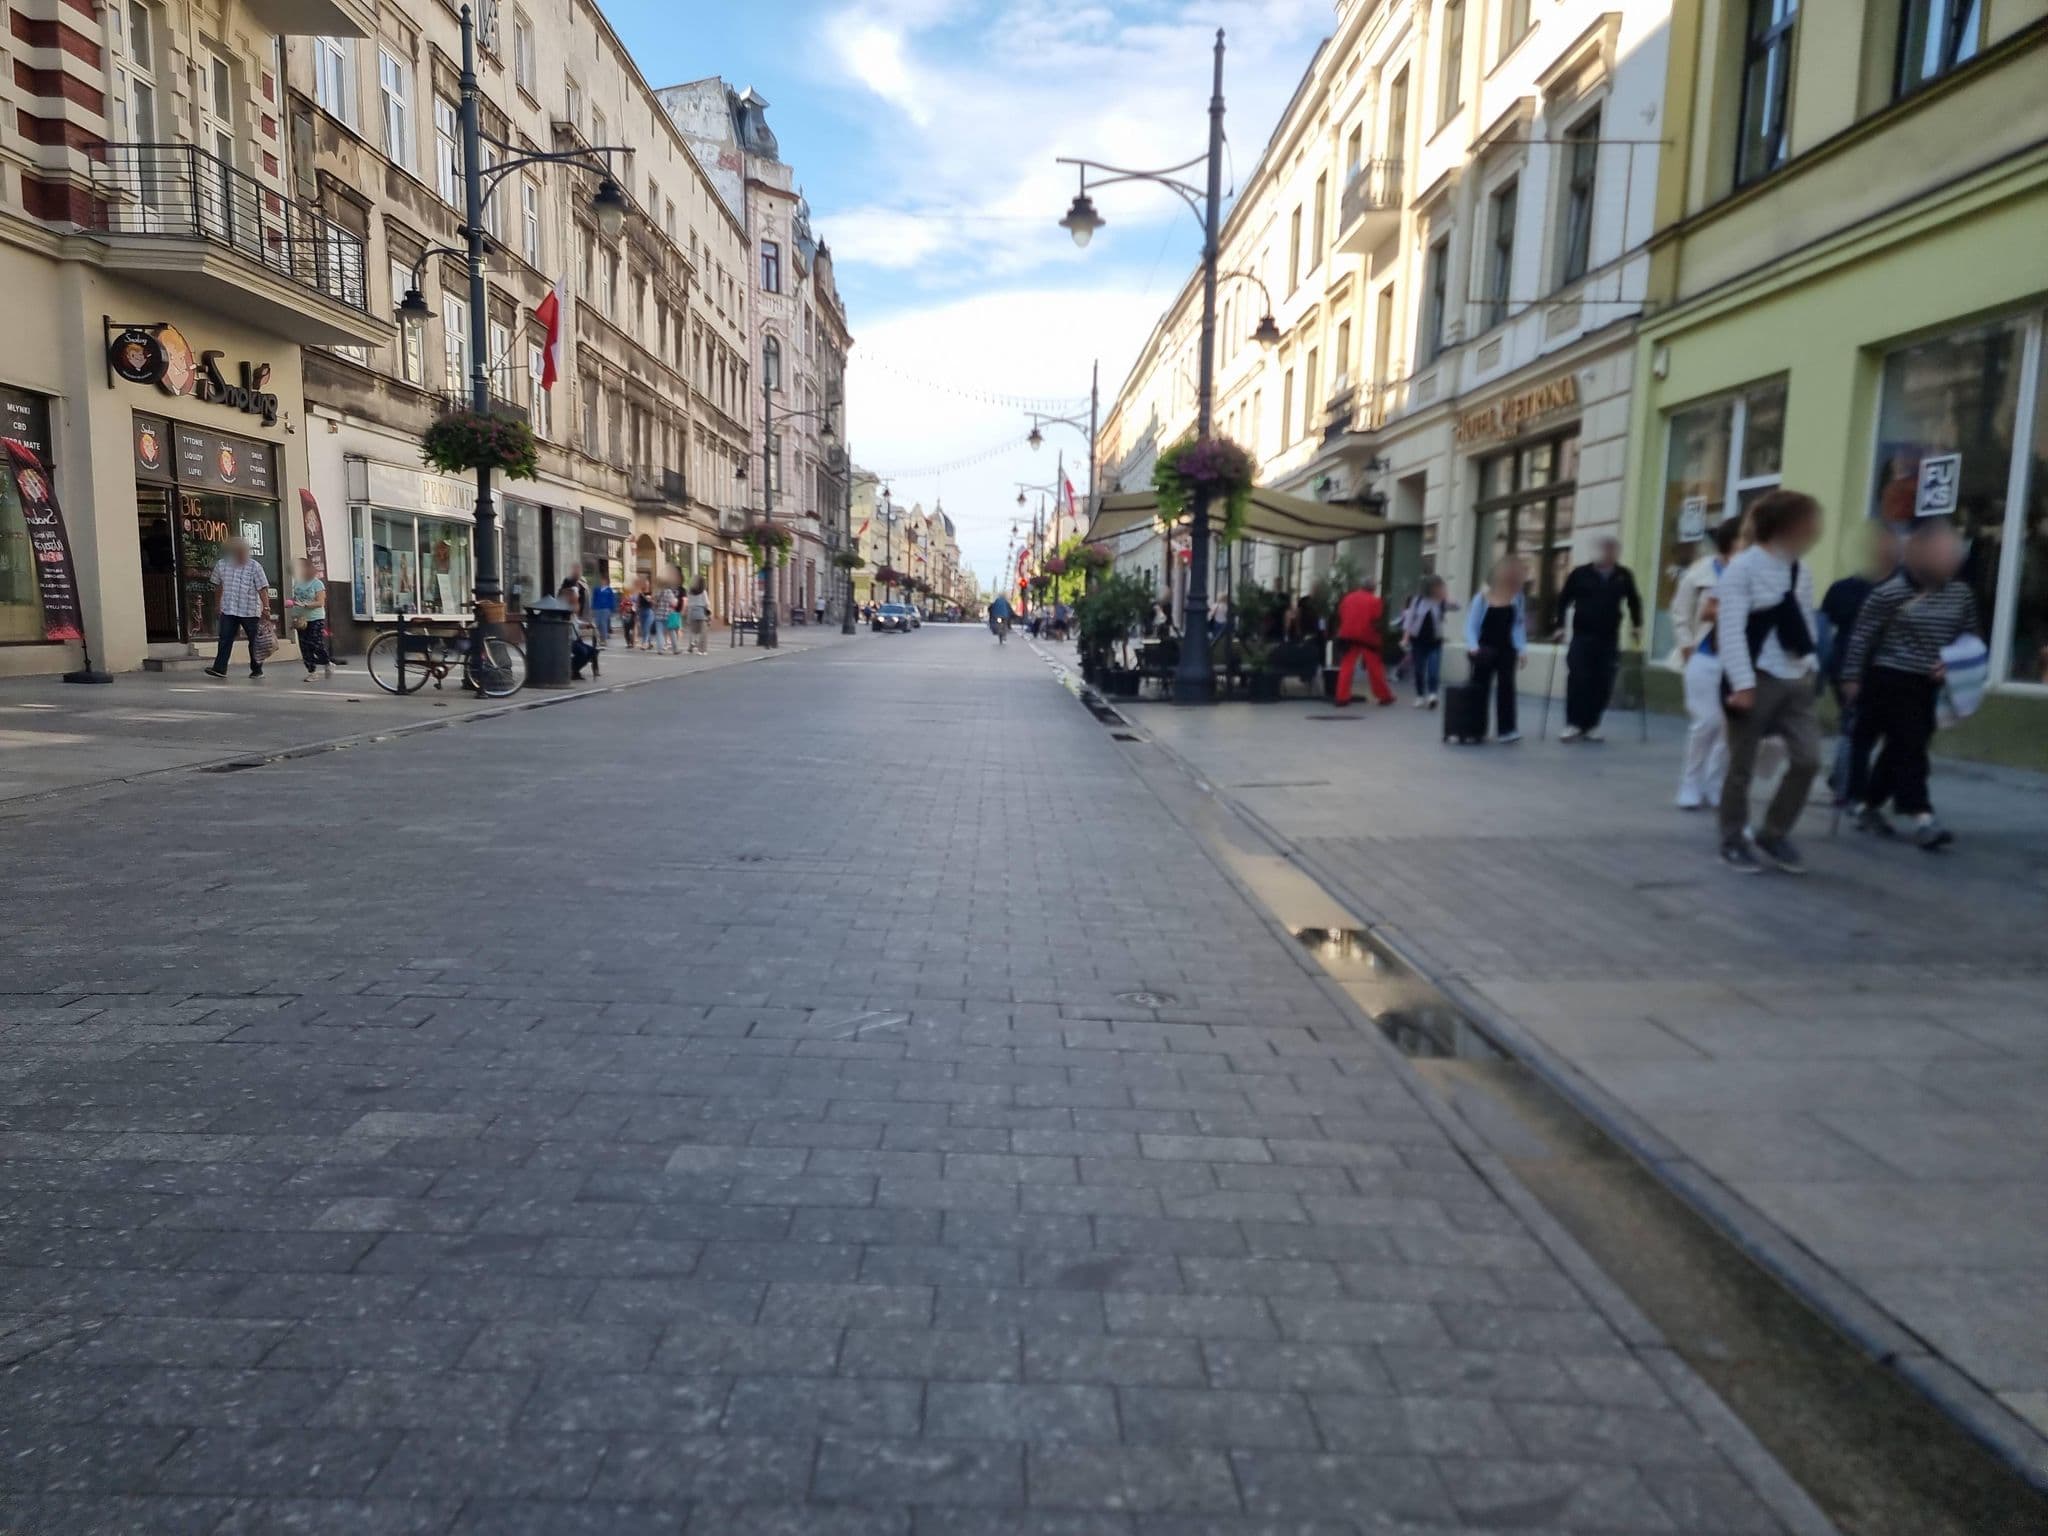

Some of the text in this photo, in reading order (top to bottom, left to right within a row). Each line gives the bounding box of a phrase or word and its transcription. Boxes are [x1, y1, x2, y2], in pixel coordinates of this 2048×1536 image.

[196, 350, 278, 427] Smoking
[13, 421, 27, 431] CBD
[181, 494, 202, 517] BIG
[191, 518, 229, 543] PROMO
